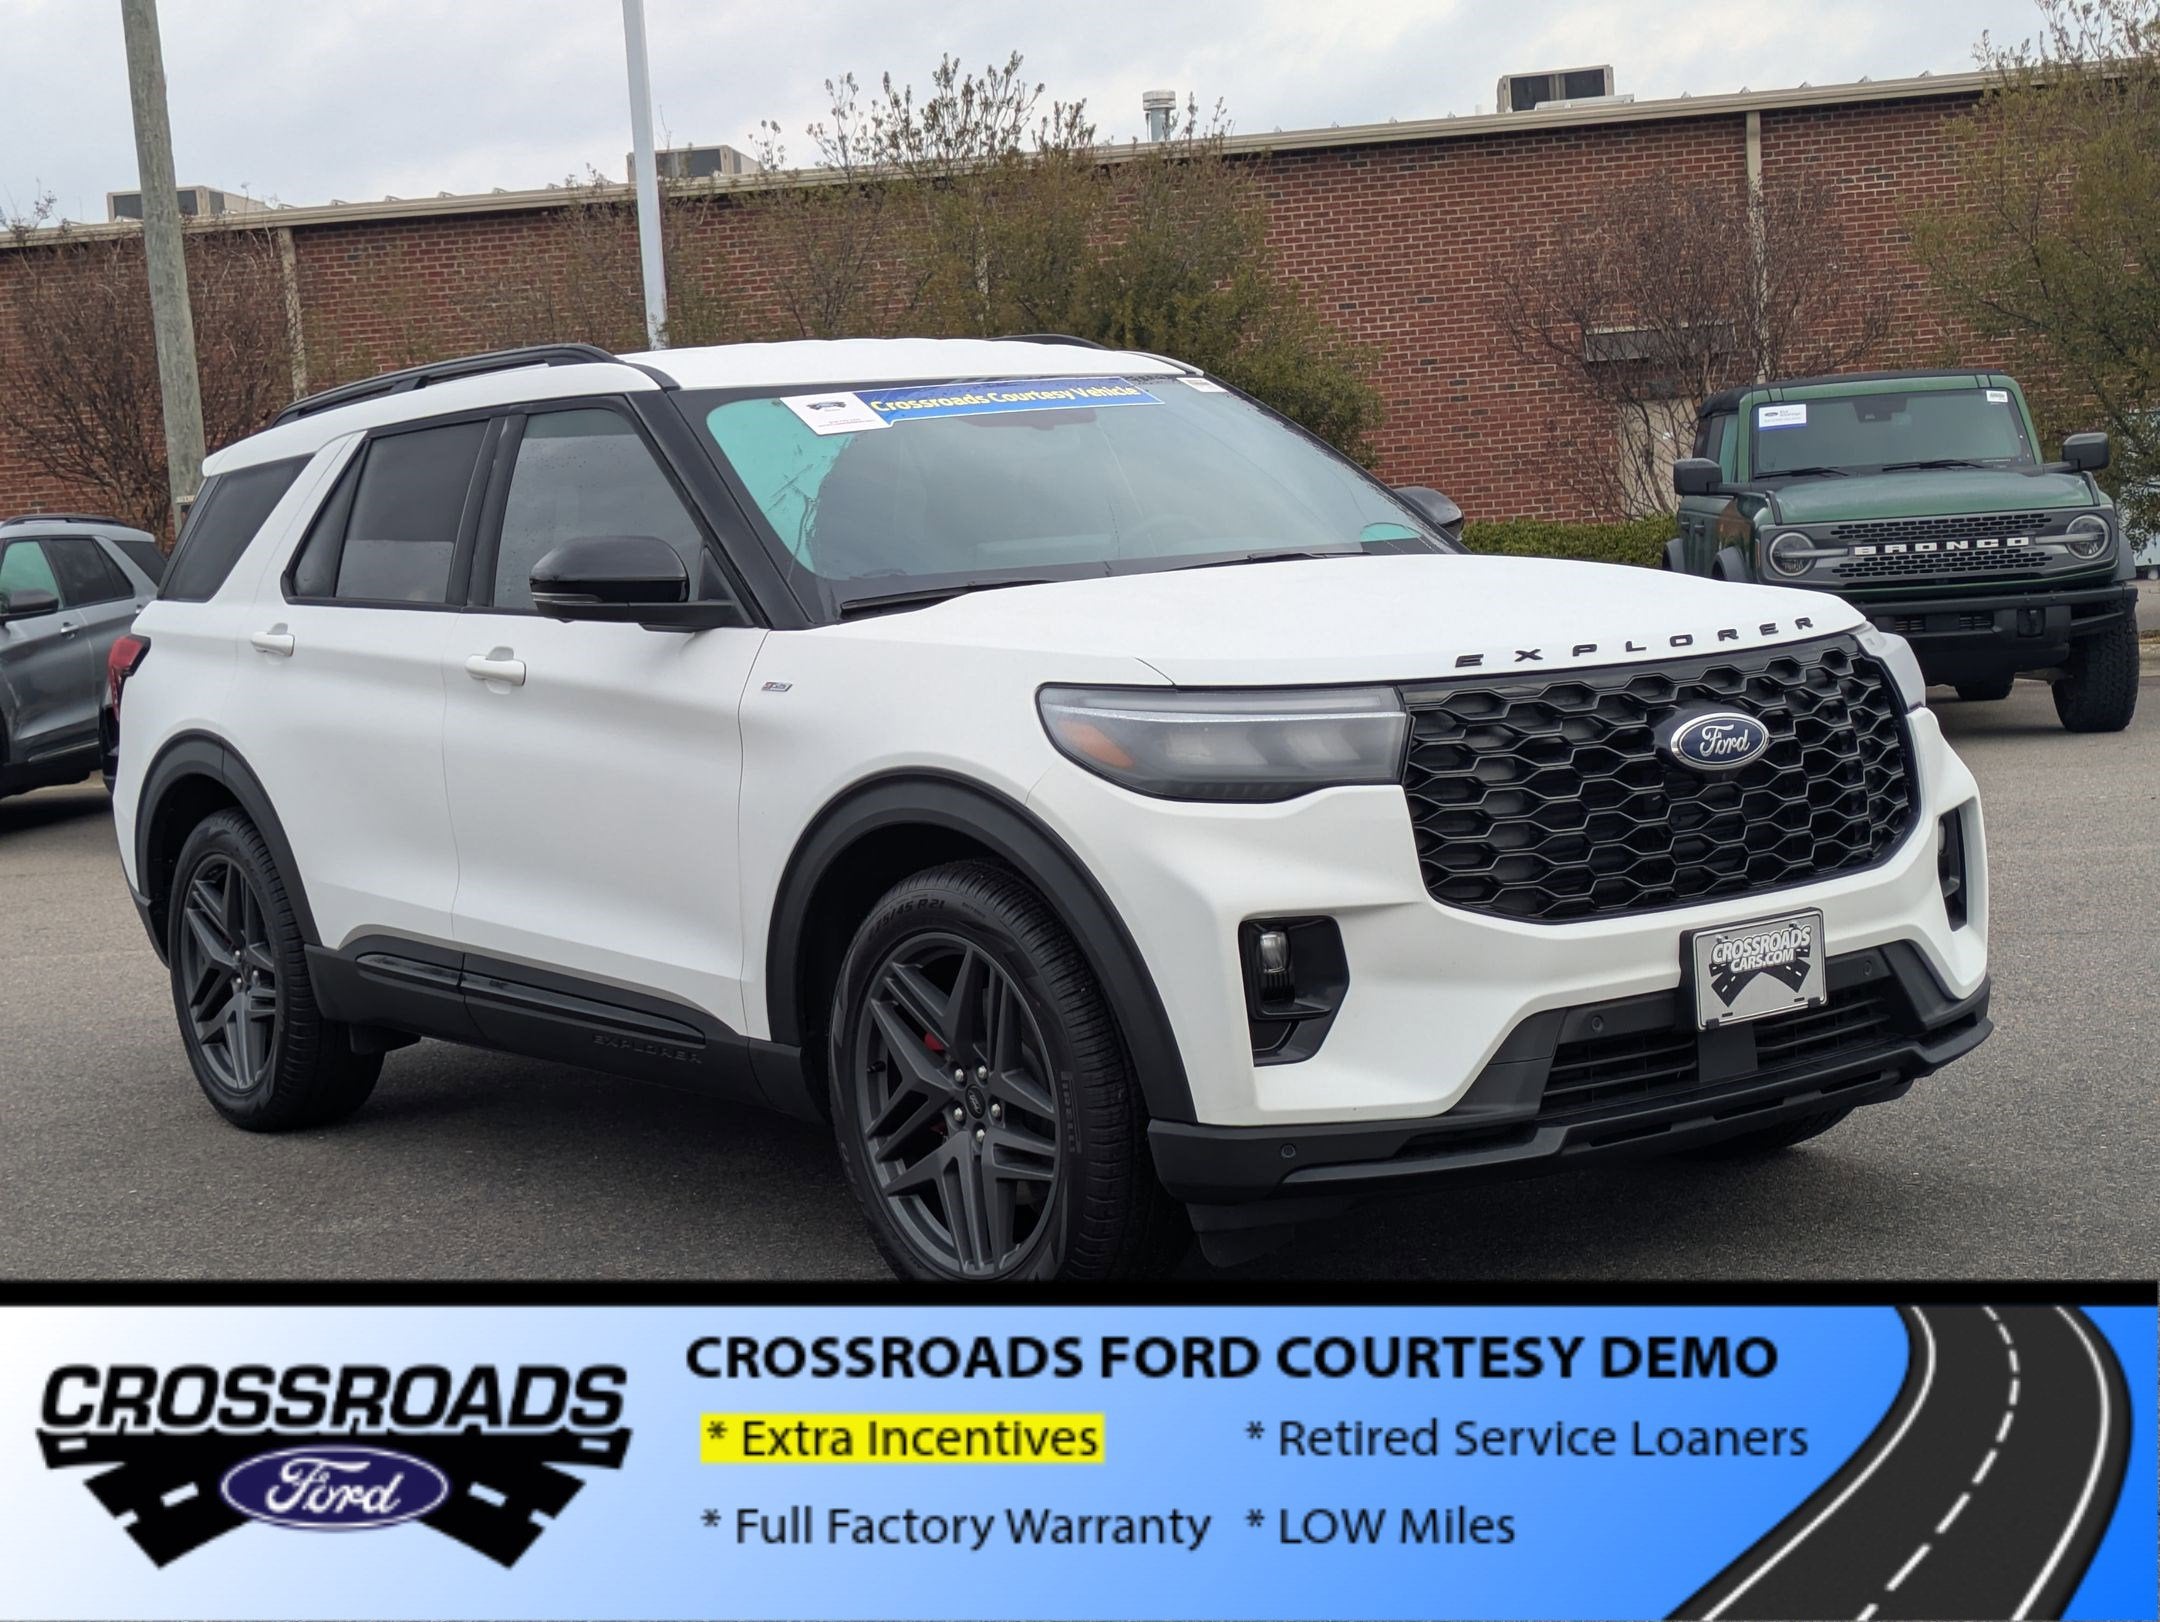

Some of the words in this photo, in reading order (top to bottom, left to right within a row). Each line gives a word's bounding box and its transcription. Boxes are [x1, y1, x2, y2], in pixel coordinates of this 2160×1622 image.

[870, 391, 990, 413] Crossroads
[989, 388, 1075, 406] Courtesy
[1075, 384, 1139, 399] Vehicle
[1853, 535, 2030, 556] BRONCO
[1454, 616, 1814, 668] EXPLORER
[1699, 723, 1751, 757] Ford
[1712, 924, 1812, 963] CROSSROADS
[1730, 948, 1795, 974] CARS.COM
